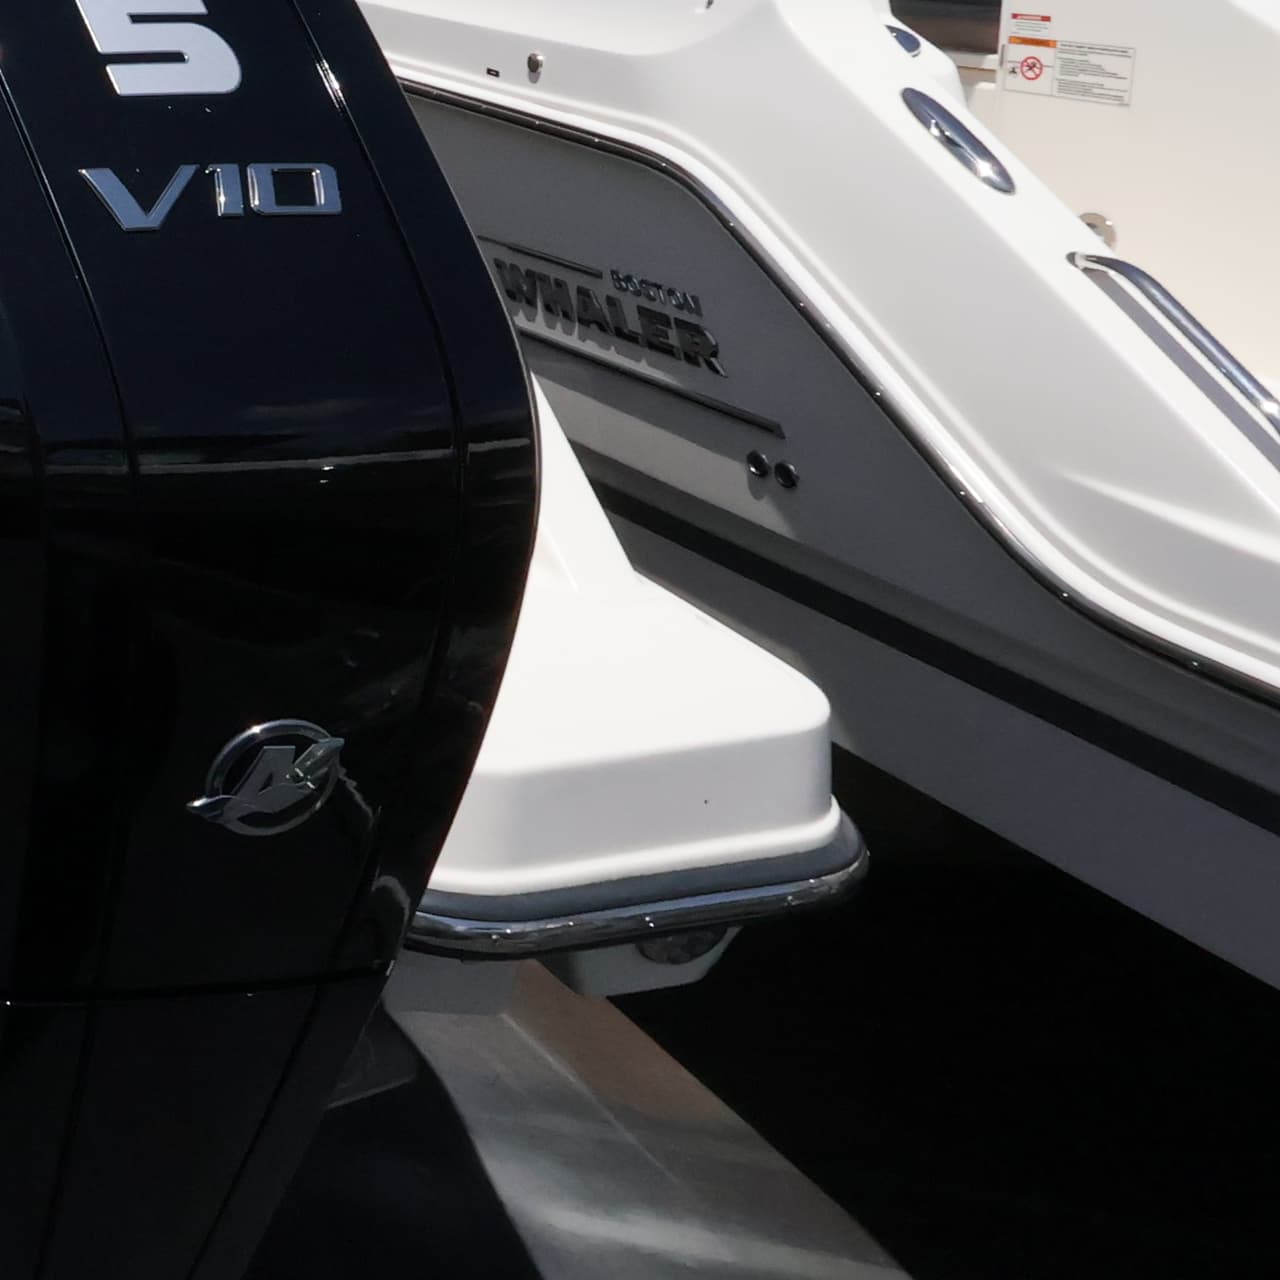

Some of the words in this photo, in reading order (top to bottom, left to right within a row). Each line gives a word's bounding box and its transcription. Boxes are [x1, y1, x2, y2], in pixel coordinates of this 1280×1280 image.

[77, 162, 343, 232] V10
[493, 257, 728, 378] WHALER
[609, 268, 705, 318] BOSTON
